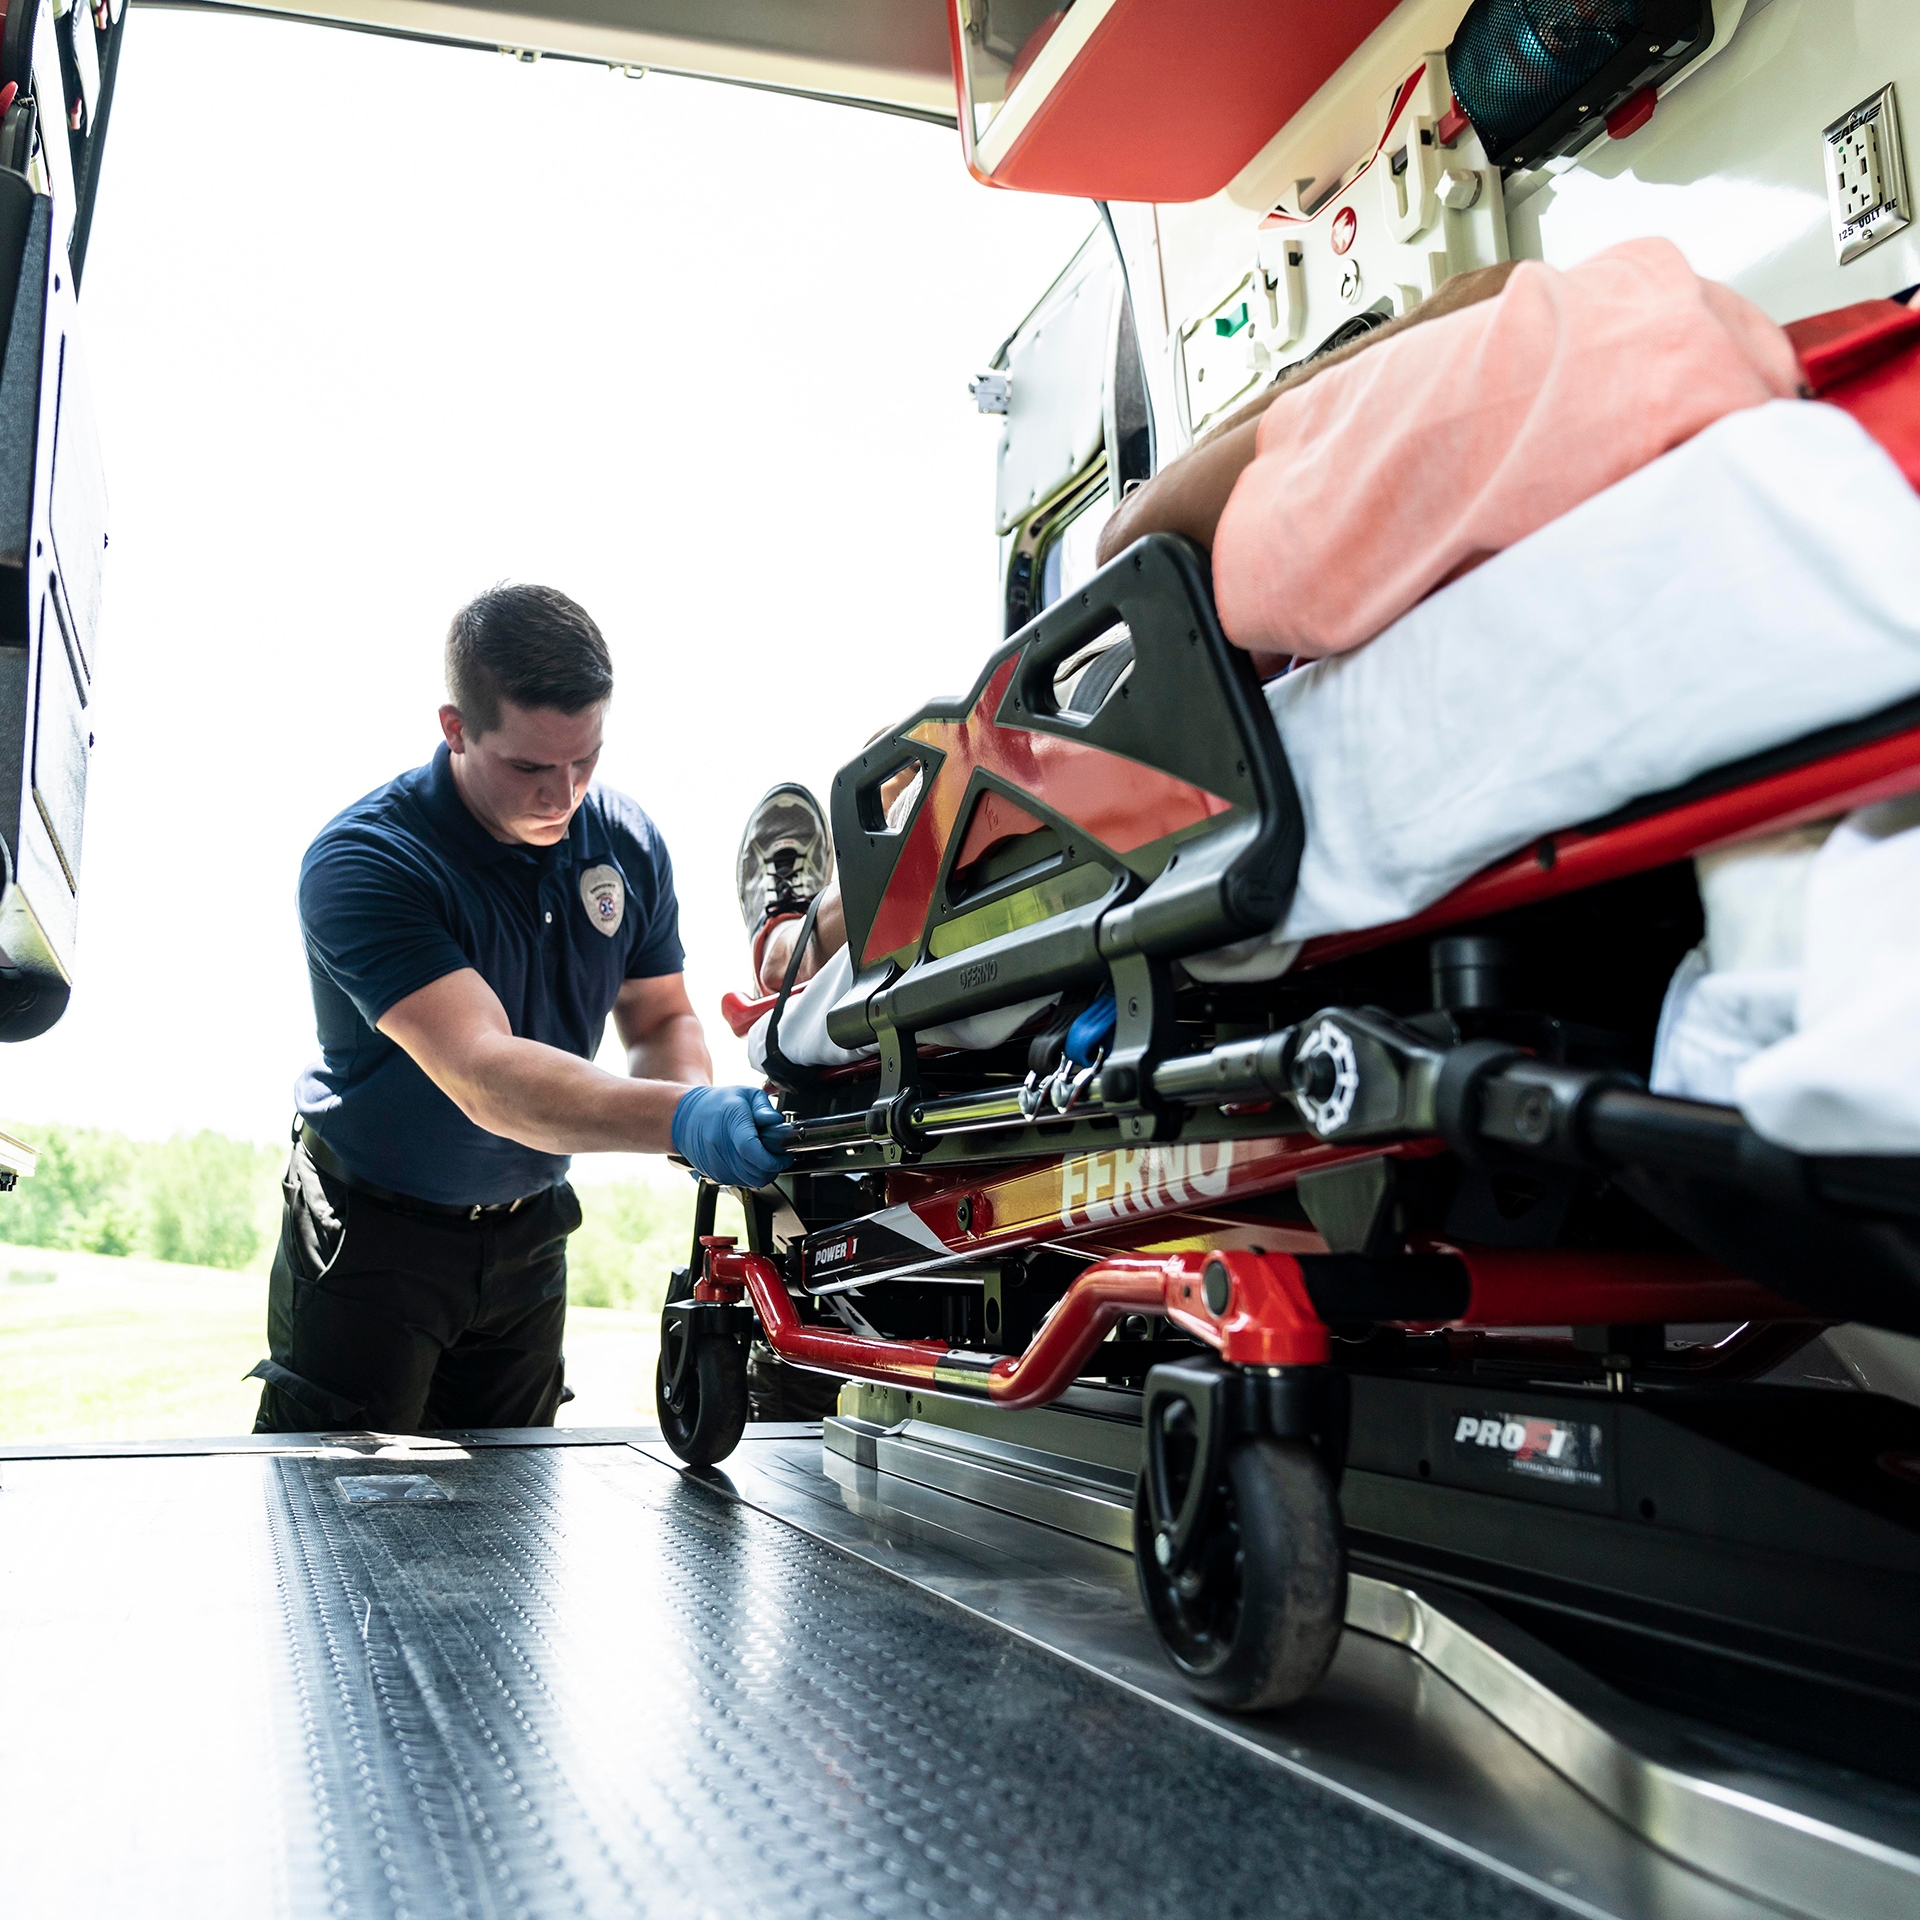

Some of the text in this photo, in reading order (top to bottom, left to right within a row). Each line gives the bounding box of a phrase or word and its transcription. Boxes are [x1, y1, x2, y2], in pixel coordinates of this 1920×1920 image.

[1838, 197, 1898, 242] 125-VOLT AC
[1060, 1140, 1234, 1228] FERNO
